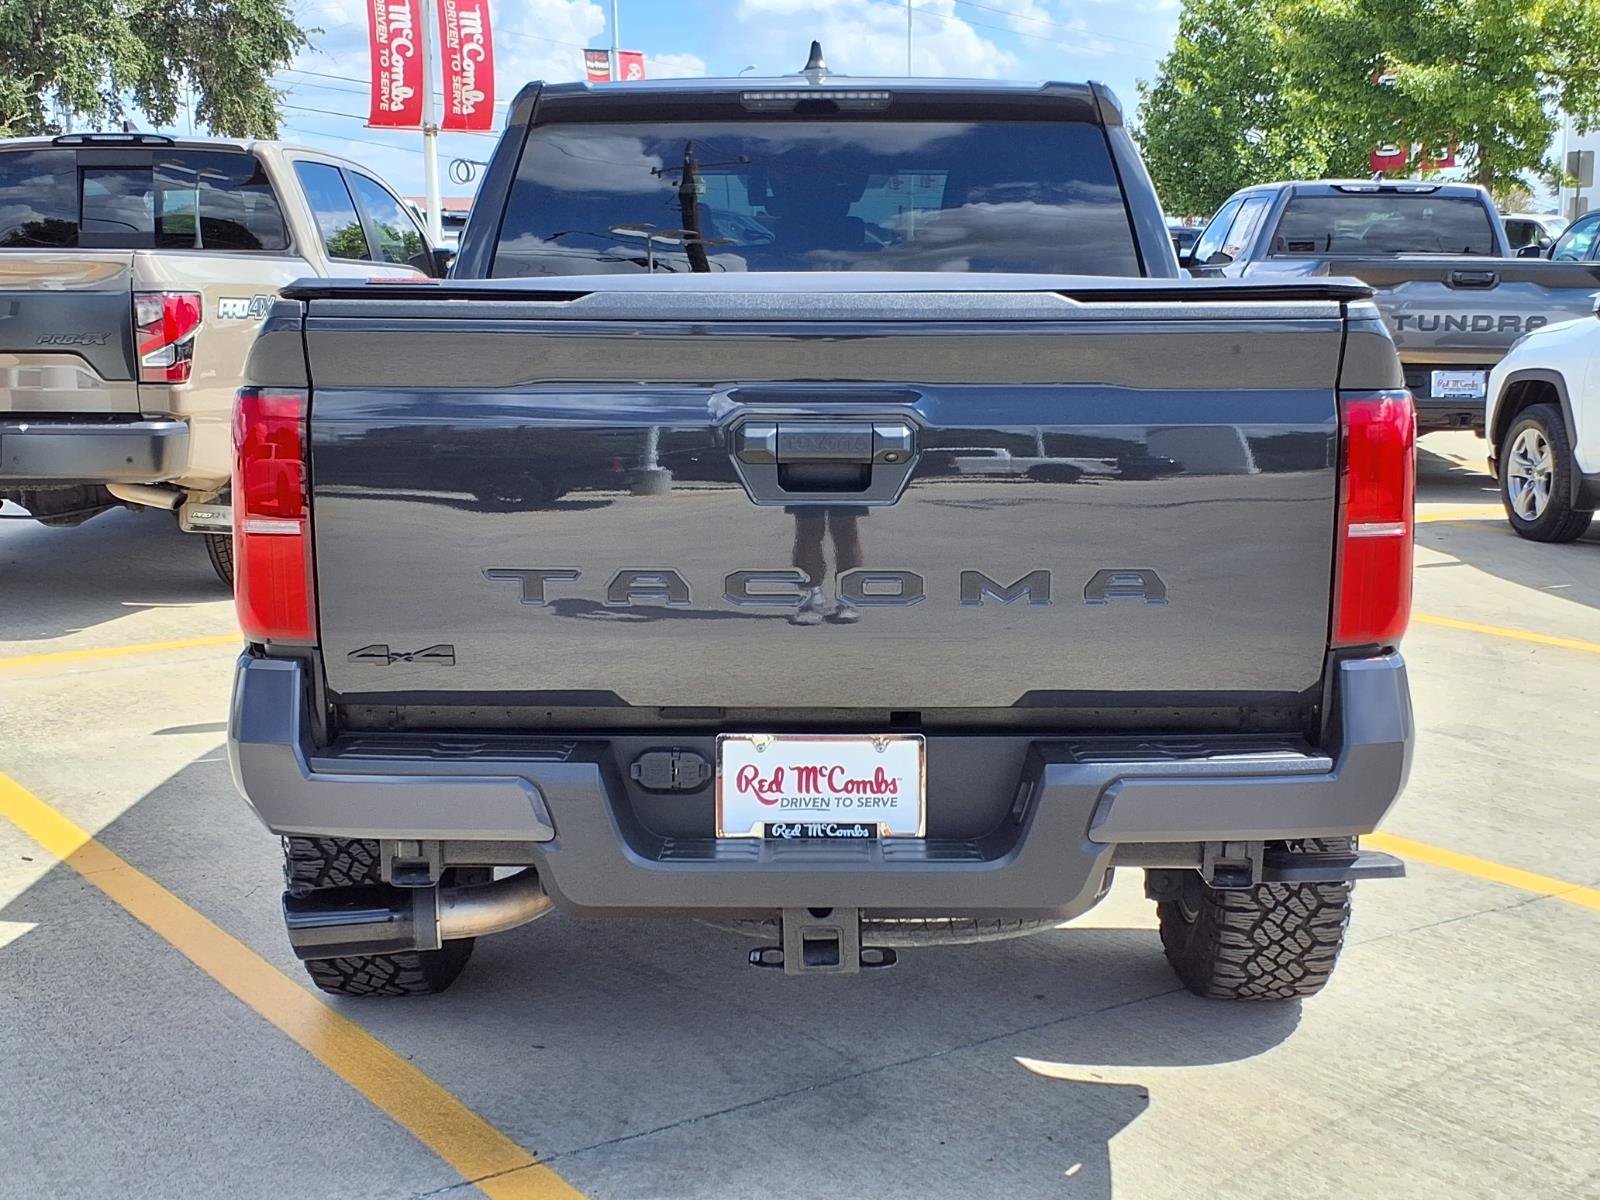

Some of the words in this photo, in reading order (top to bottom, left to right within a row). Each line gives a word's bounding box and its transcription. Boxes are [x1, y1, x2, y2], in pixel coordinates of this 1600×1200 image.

[447, 1, 460, 48] DRIVEN
[380, 48, 389, 67] TO
[388, 0, 415, 112] McCombs
[451, 53, 461, 72] TO
[459, 4, 485, 115] McCombs
[380, 71, 389, 111] SERVE
[452, 75, 461, 114] SERVE
[1391, 314, 1548, 332] TUNDRA
[481, 567, 1168, 606] TACOMA
[736, 764, 784, 806] Red
[788, 765, 898, 794] McCombs
[779, 797, 831, 809] DRIVEN
[835, 797, 853, 808] TO
[856, 797, 898, 808] SERVE
[771, 824, 801, 838] Red
[803, 824, 869, 837] McCombs
